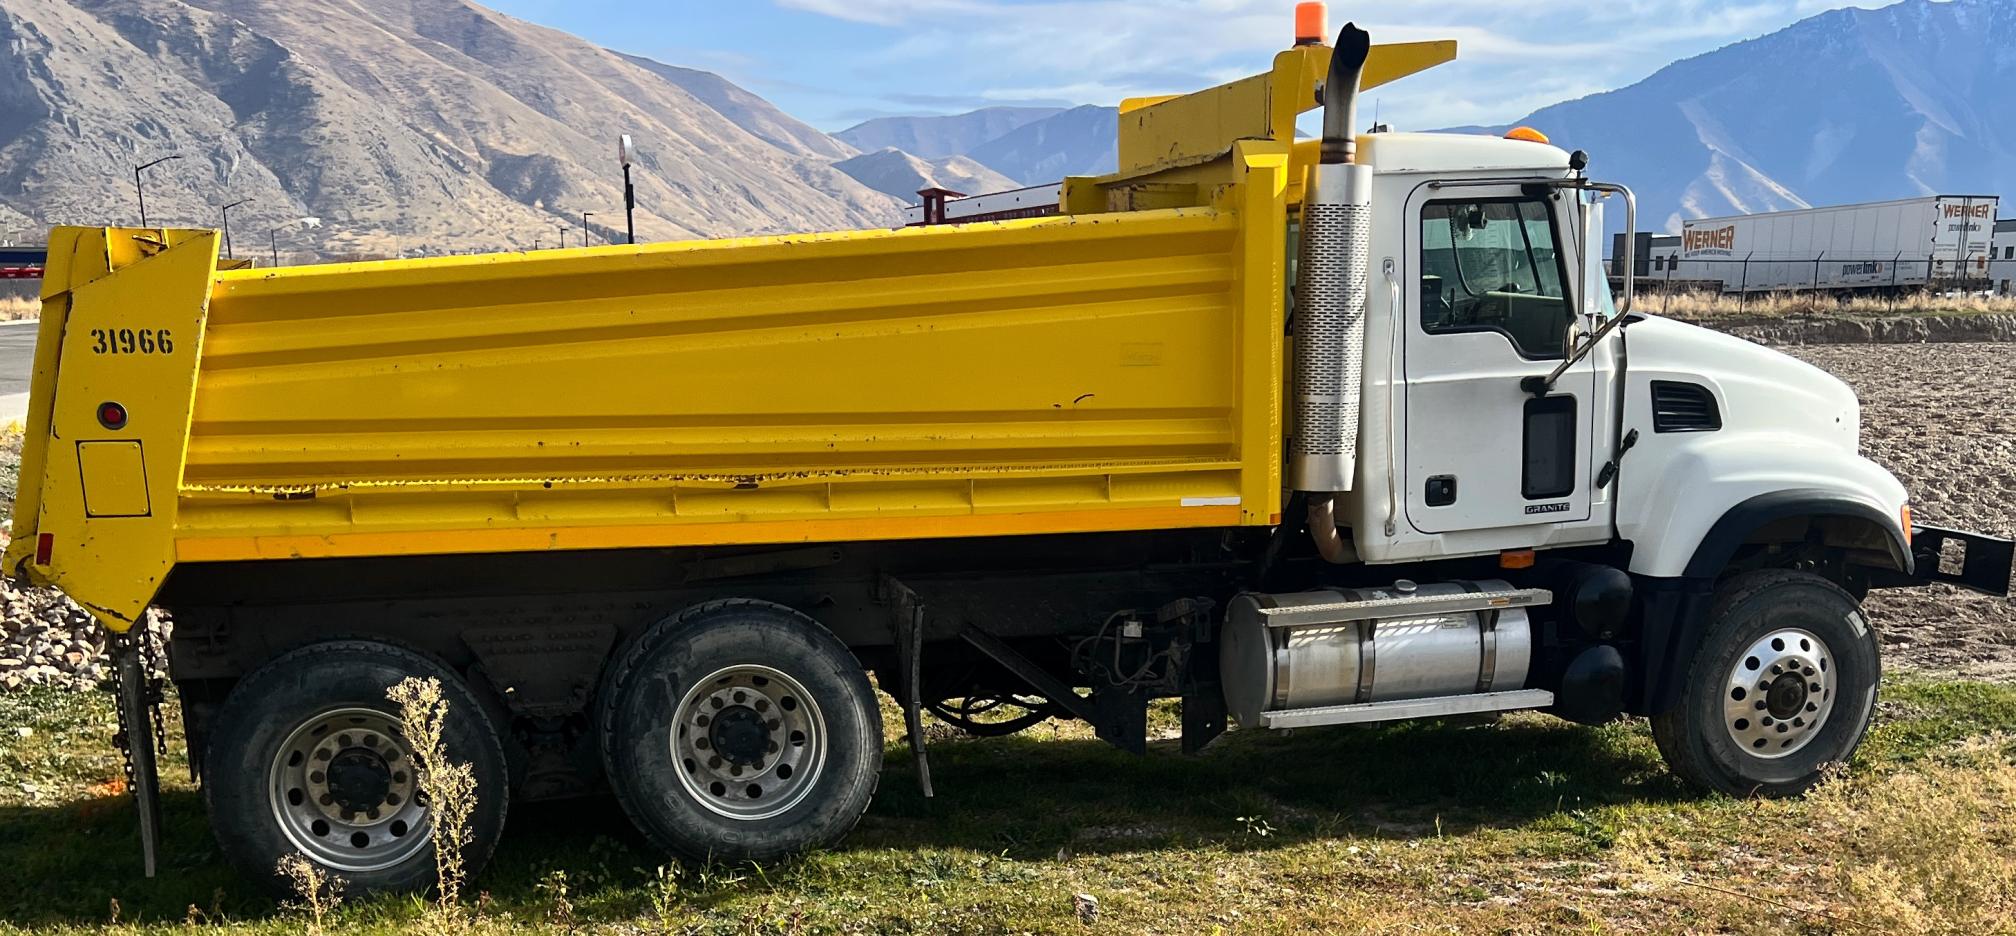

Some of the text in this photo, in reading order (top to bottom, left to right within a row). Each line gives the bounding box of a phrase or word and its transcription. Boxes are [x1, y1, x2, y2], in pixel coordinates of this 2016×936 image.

[1943, 204, 1989, 219] WERNER
[1683, 225, 1735, 252] WERNER
[90, 328, 174, 354] 31966
[1526, 503, 1570, 513] GRANITE
